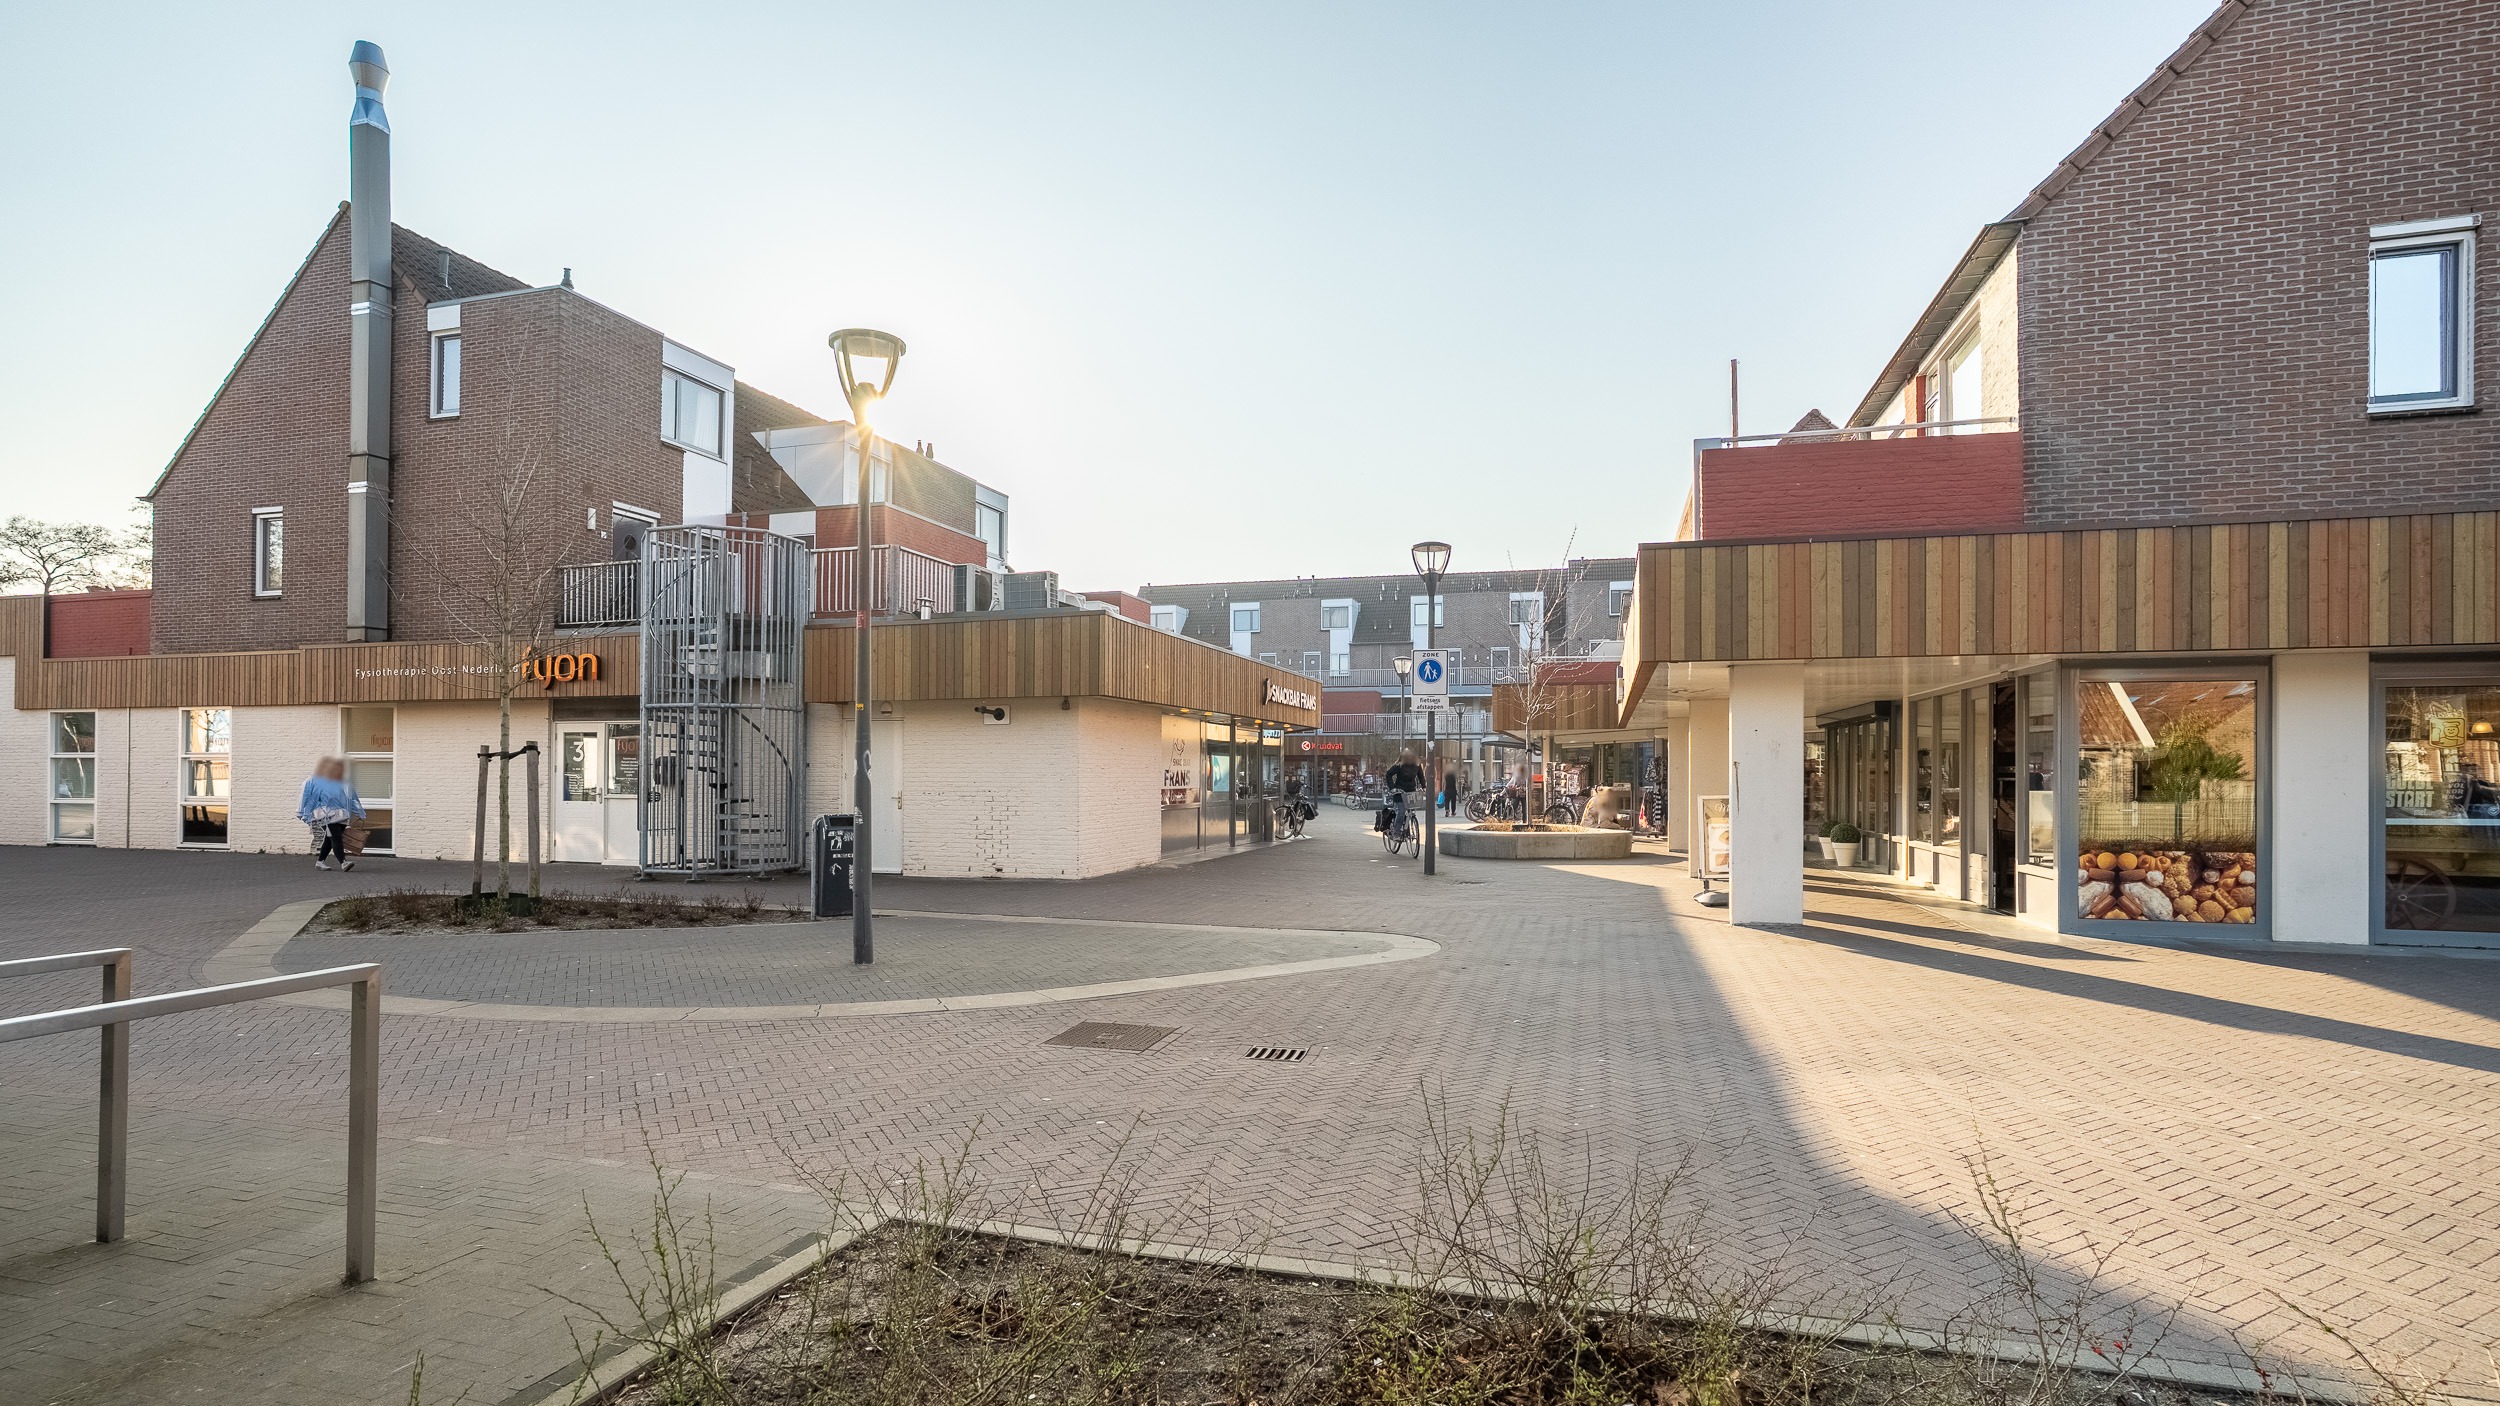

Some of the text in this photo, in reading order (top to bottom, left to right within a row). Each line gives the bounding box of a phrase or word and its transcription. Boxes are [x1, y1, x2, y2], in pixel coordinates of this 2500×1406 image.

[355, 667, 427, 680] Fysiotherapie
[431, 666, 457, 675] Oost
[1271, 684, 1317, 711] SNACKBAR FRANS
[572, 741, 585, 762] 3
[616, 739, 639, 754] fyo
[1311, 742, 1343, 750] Kuidvat
[1163, 769, 1191, 787] FRANS
[2385, 790, 2435, 808] START
